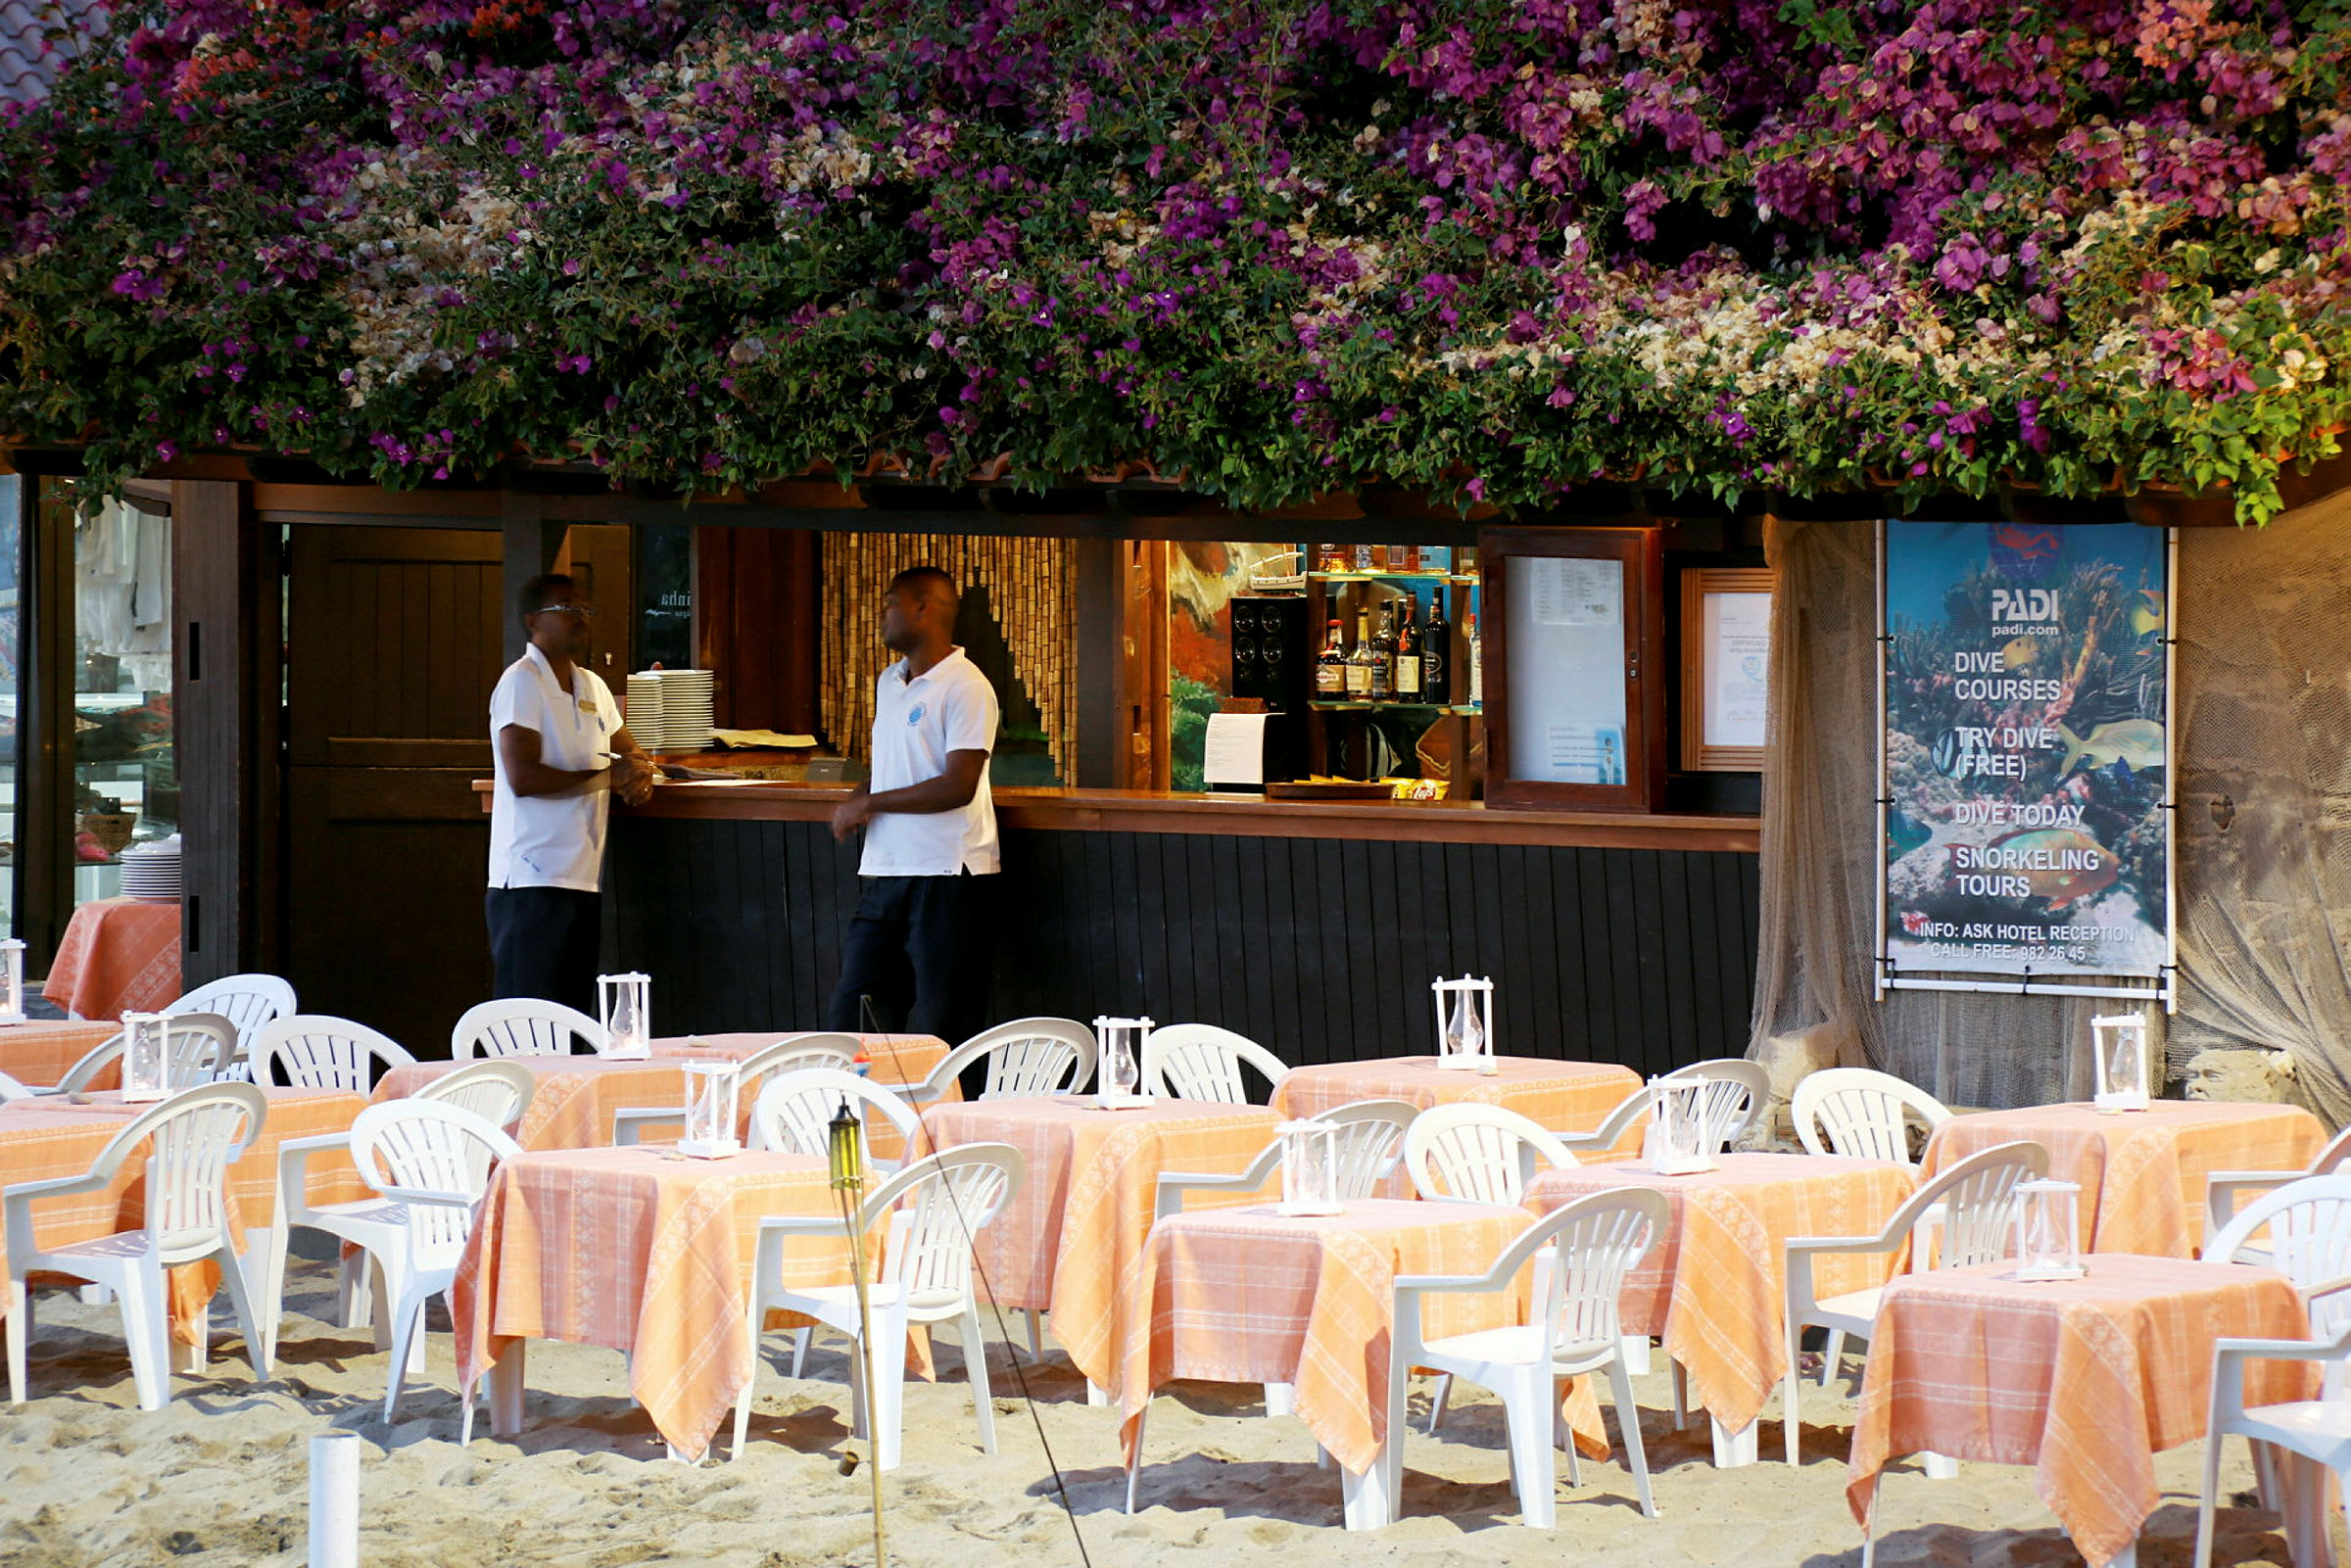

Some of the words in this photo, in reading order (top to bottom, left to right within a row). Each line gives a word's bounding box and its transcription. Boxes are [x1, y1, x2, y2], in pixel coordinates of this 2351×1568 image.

[1991, 589, 2058, 621] PADI
[1991, 623, 2059, 639] padi.com
[1955, 651, 2005, 673] DIVE
[1955, 679, 2061, 700] COURSES
[1955, 727, 1996, 748] TRY
[2003, 728, 2053, 749] DIVE
[1955, 753, 2027, 782] (FREE)
[1956, 803, 2005, 825] DIVE
[2012, 804, 2085, 827] TODAY
[1956, 847, 2099, 871] SNORKELING
[1956, 875, 2031, 897] TOURS
[1920, 923, 1959, 937] INFO:
[1962, 924, 1993, 938] ASK
[1997, 925, 2045, 940] HOTEL
[2049, 926, 2135, 942] RECEPTION
[1931, 942, 1969, 958] CALL
[1973, 943, 2016, 959] FREE:
[2021, 945, 2044, 961] 982
